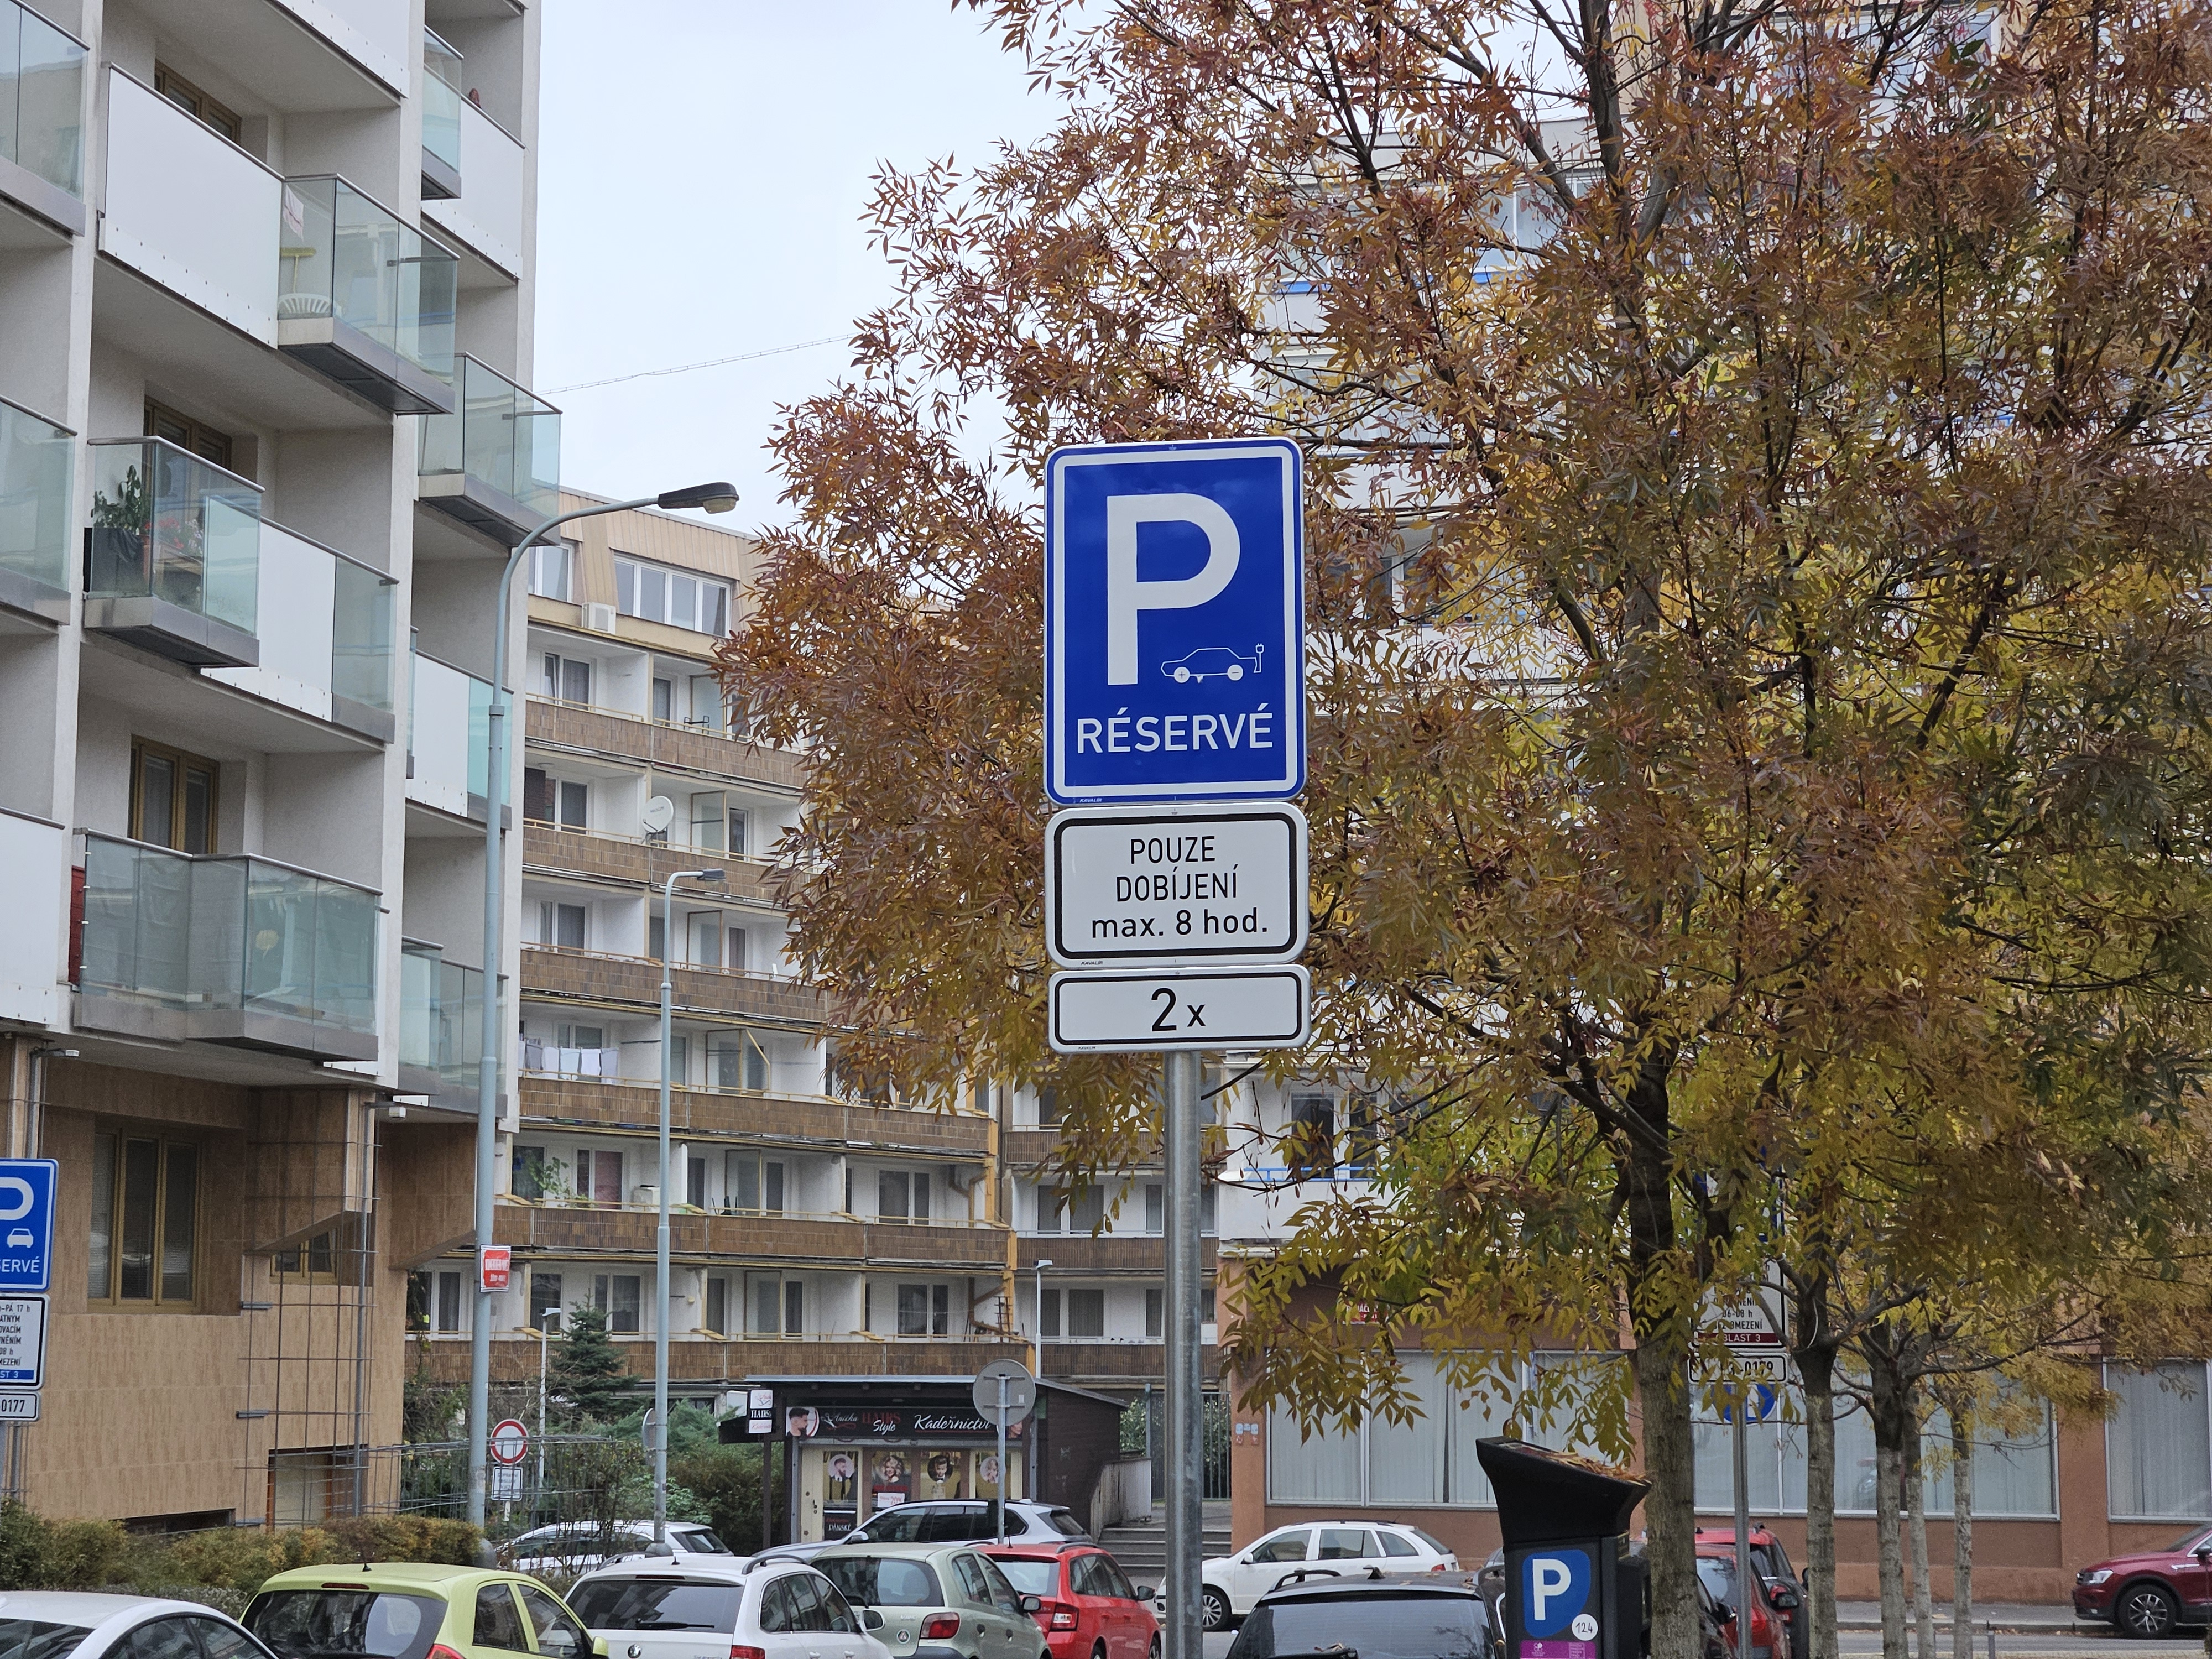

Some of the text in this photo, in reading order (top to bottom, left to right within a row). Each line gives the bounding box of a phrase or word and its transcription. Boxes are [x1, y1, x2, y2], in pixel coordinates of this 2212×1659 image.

[1107, 493, 1240, 685] P
[1078, 703, 1272, 753] RÉSERVÉ
[1131, 836, 1215, 864] POUZE
[1117, 864, 1239, 902] DOBÍJENÍ
[1092, 907, 1268, 938] max. 8 hod.
[0, 1256, 40, 1273] ERVÉ
[1755, 1334, 1761, 1342] 3
[1532, 1559, 1571, 1620] P
[1575, 1622, 1593, 1634] 124
